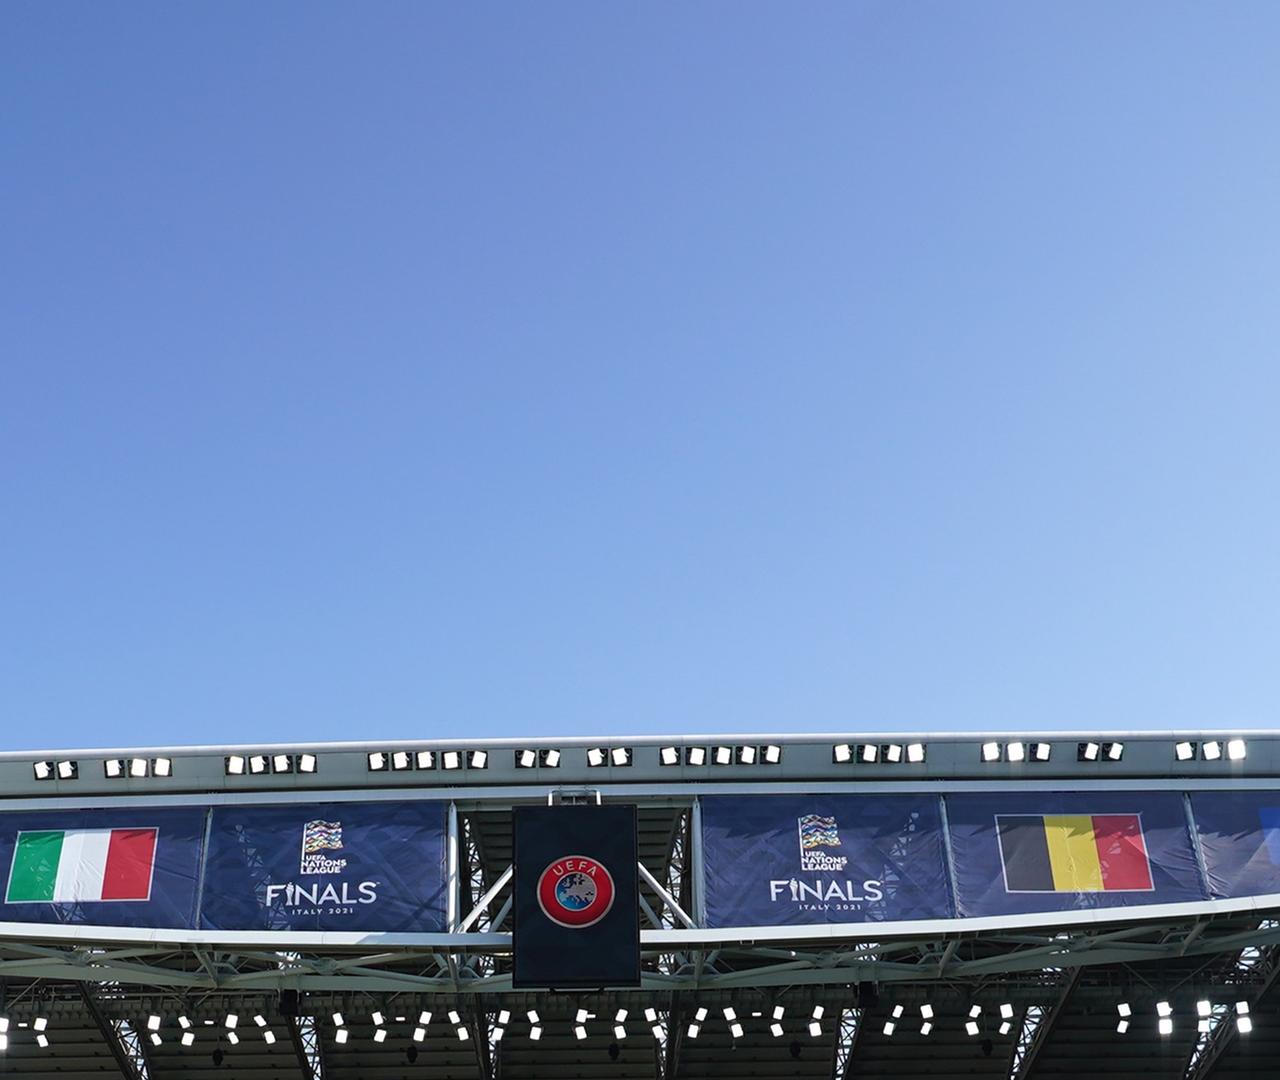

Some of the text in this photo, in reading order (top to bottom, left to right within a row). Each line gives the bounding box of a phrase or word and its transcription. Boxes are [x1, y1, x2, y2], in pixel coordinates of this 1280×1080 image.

[301, 859, 347, 868] NATIONS
[801, 856, 847, 865] NATIONS
[300, 866, 341, 875] LEAGUE
[553, 861, 597, 876] UEFA
[801, 863, 843, 871] LEAGUE
[266, 881, 377, 906] FINALS
[770, 878, 883, 902] FINALS
